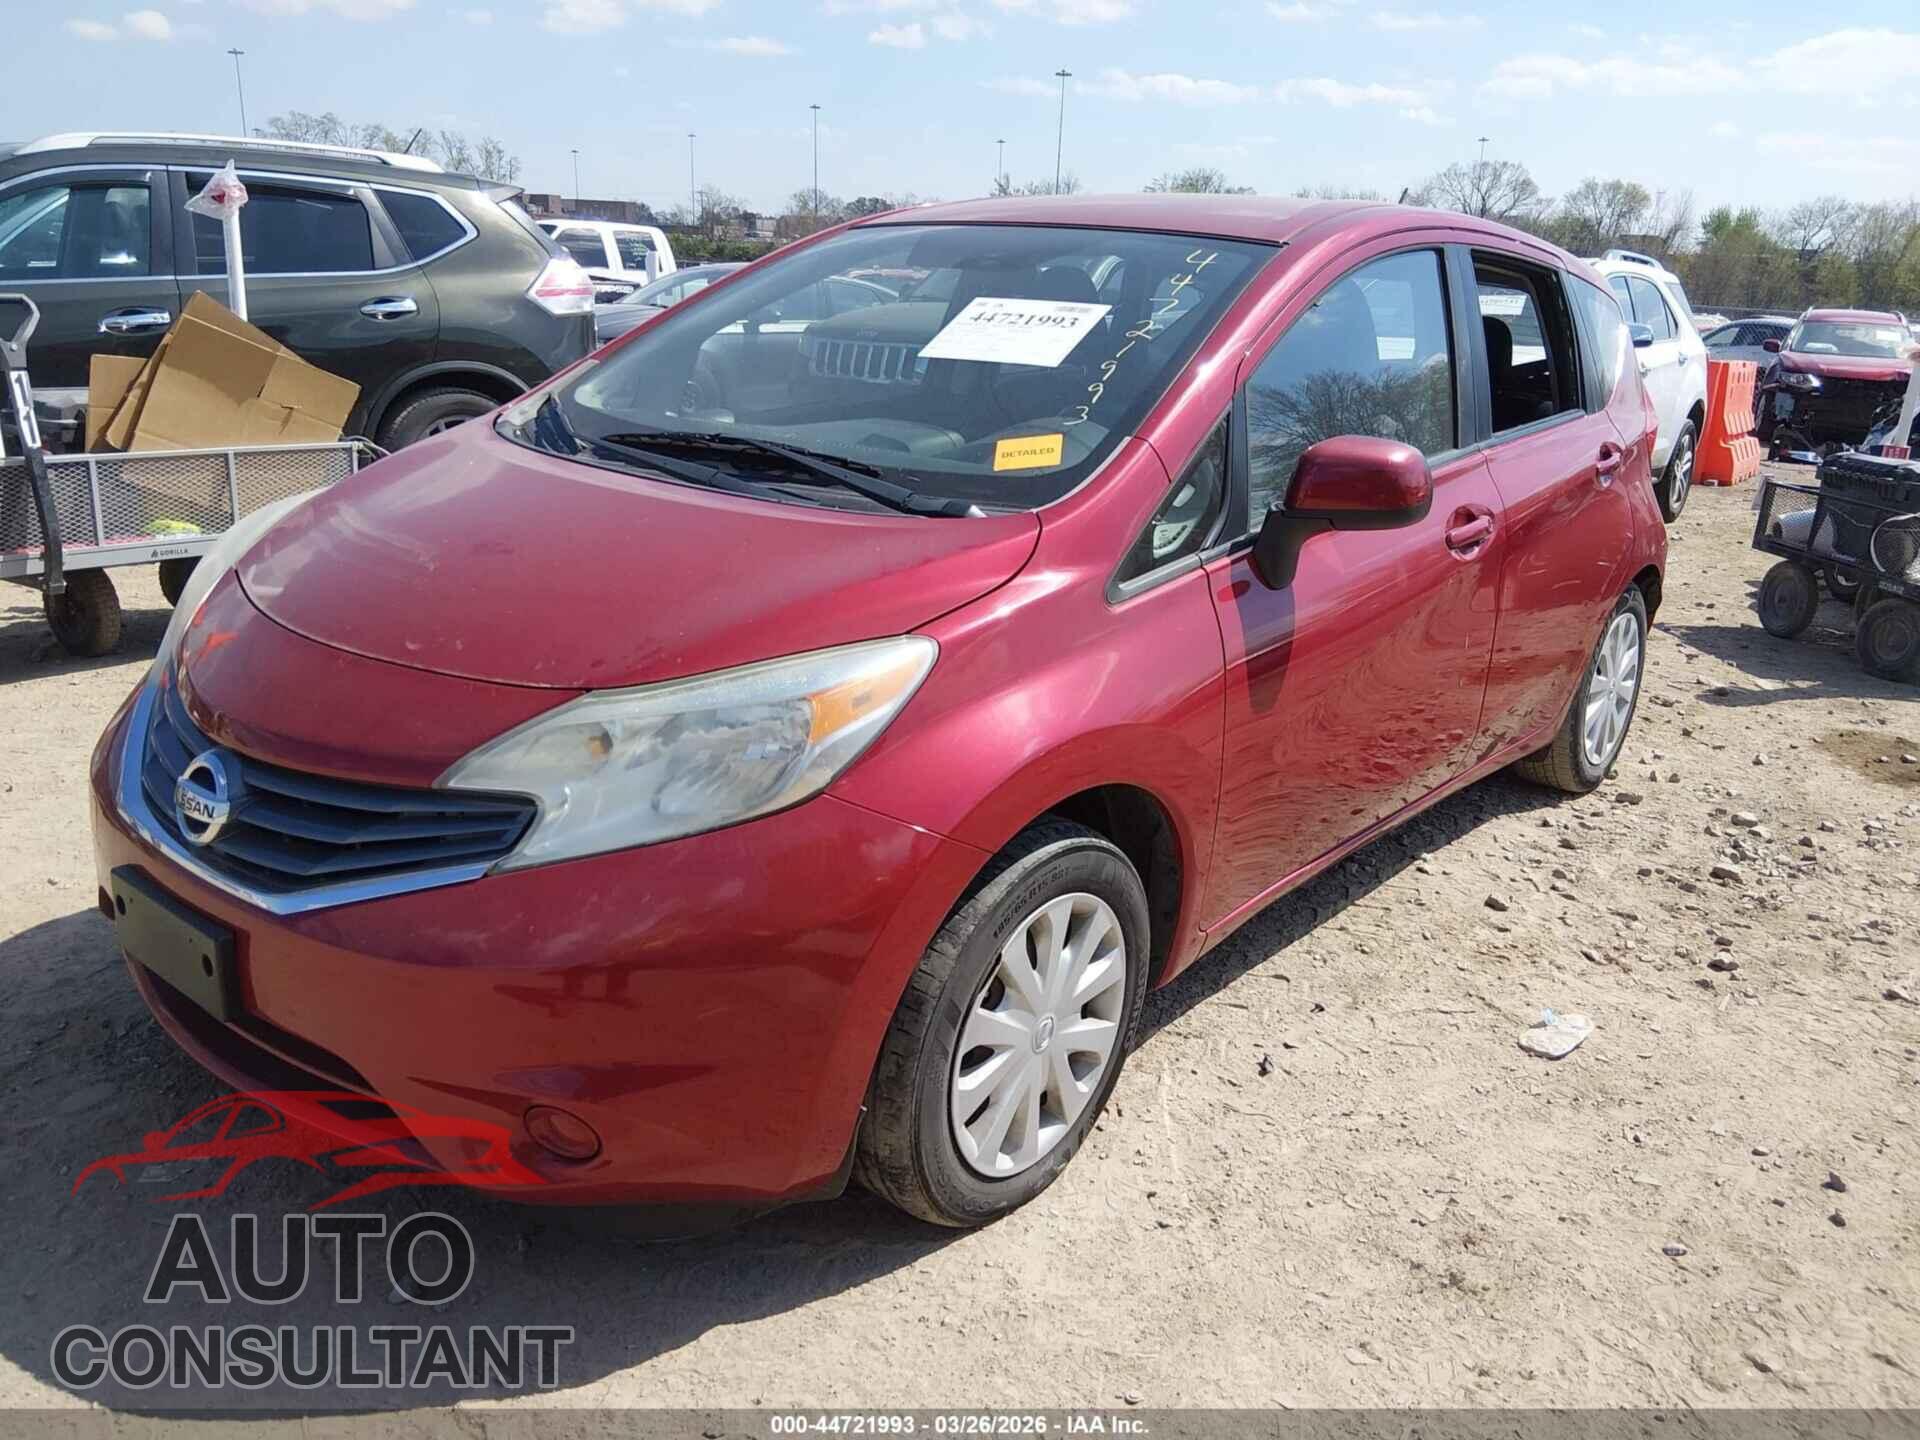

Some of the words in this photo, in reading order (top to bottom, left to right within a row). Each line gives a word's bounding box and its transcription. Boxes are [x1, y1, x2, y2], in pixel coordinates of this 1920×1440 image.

[969, 311, 1080, 329] 44721993
[1063, 248, 1220, 426] 44721993
[1001, 447, 1055, 459] DETAILED
[180, 789, 215, 818] SSAN
